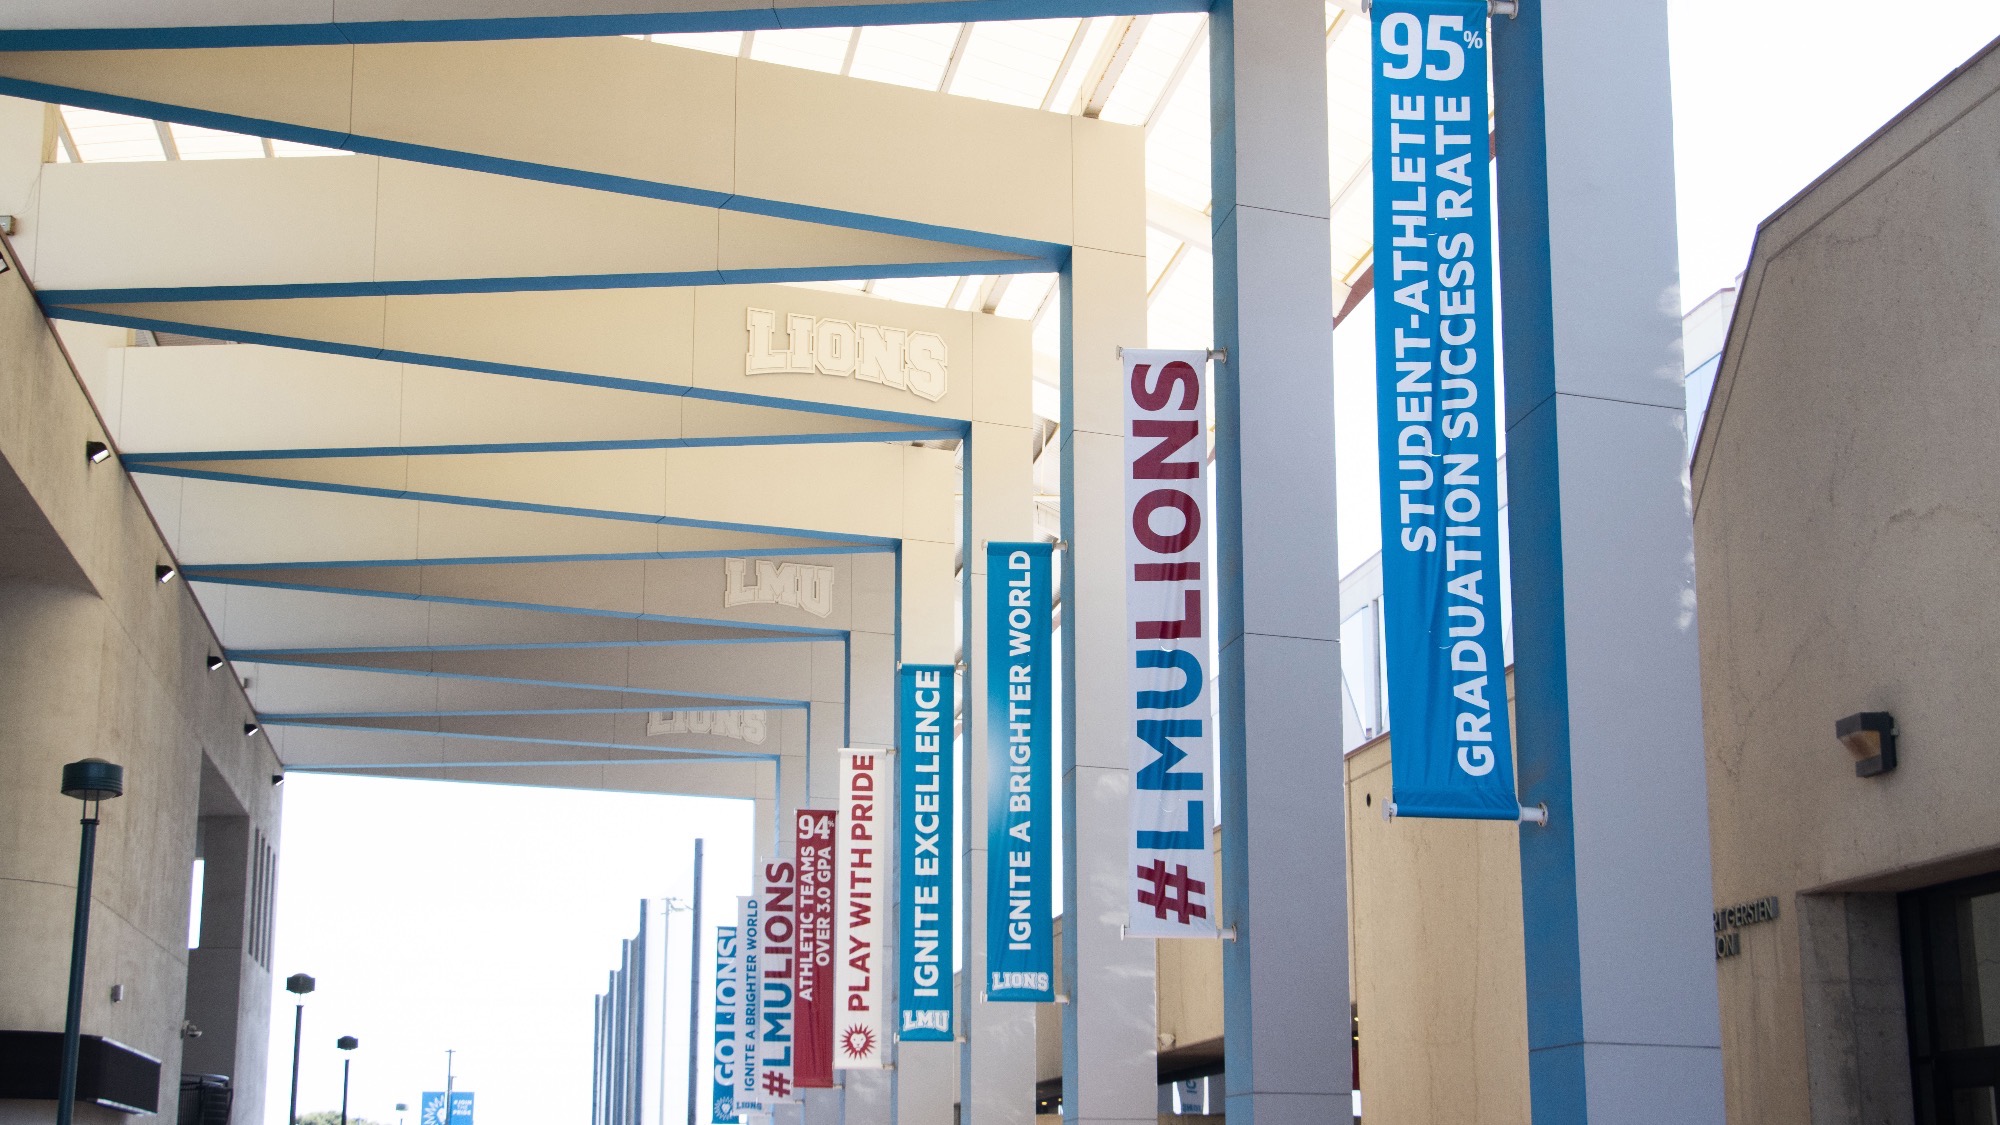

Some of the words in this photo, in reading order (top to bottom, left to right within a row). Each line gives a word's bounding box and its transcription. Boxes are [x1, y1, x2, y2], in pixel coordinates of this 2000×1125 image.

[1434, 95, 1473, 219] RATE
[745, 306, 948, 402] LIONS
[1390, 94, 1437, 553] STUDENT-ATHLETE
[1437, 232, 1479, 439] SUCCESS
[724, 557, 834, 618] LMU
[1008, 550, 1032, 657] WORLD
[1442, 453, 1495, 777] GRADUATION
[1130, 360, 1207, 924] #LMULIONS
[915, 670, 940, 876] EXCELLENCE
[1009, 664, 1032, 812] BRIGHTER
[851, 754, 874, 840] PRIDE
[1009, 820, 1031, 843] A
[800, 845, 815, 908] TEAMS
[817, 846, 831, 882] GPA
[817, 887, 831, 913] 3.0
[849, 848, 872, 929] WITH
[1008, 851, 1032, 951] IGNITE
[746, 899, 758, 950] WORLD
[816, 917, 830, 966] OVER
[914, 886, 939, 997] IGNITE
[1726, 896, 1778, 927] GERSTEN
[745, 955, 757, 1025] BRIGHTER
[762, 862, 795, 1098] #LMULIONS
[799, 913, 814, 1001] ATHLETIC
[847, 935, 871, 1012] PLAY
[991, 971, 1049, 992] LIONS
[745, 1030, 756, 1040] A
[902, 1009, 950, 1033] LMU
[714, 1038, 735, 1086] GO
[744, 1043, 755, 1091] IGNITE
[736, 1101, 762, 1111] LIONS
